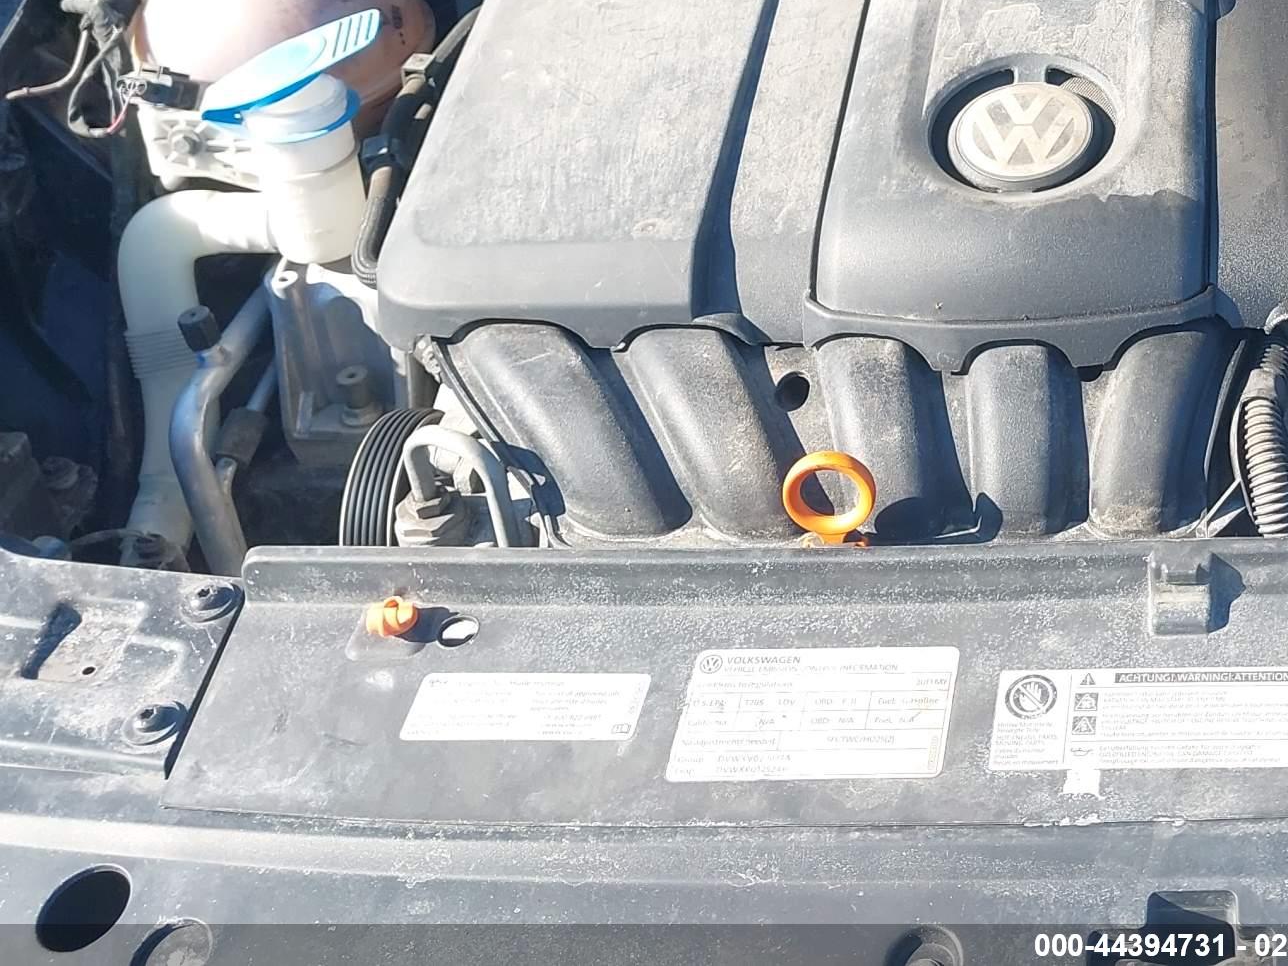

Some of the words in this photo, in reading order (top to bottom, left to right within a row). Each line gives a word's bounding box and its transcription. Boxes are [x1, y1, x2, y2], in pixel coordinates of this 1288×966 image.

[727, 656, 801, 665] VOLKSWAGEN
[1118, 673, 1175, 683] ACHTUNG!
[1177, 673, 1233, 682] WARNING!
